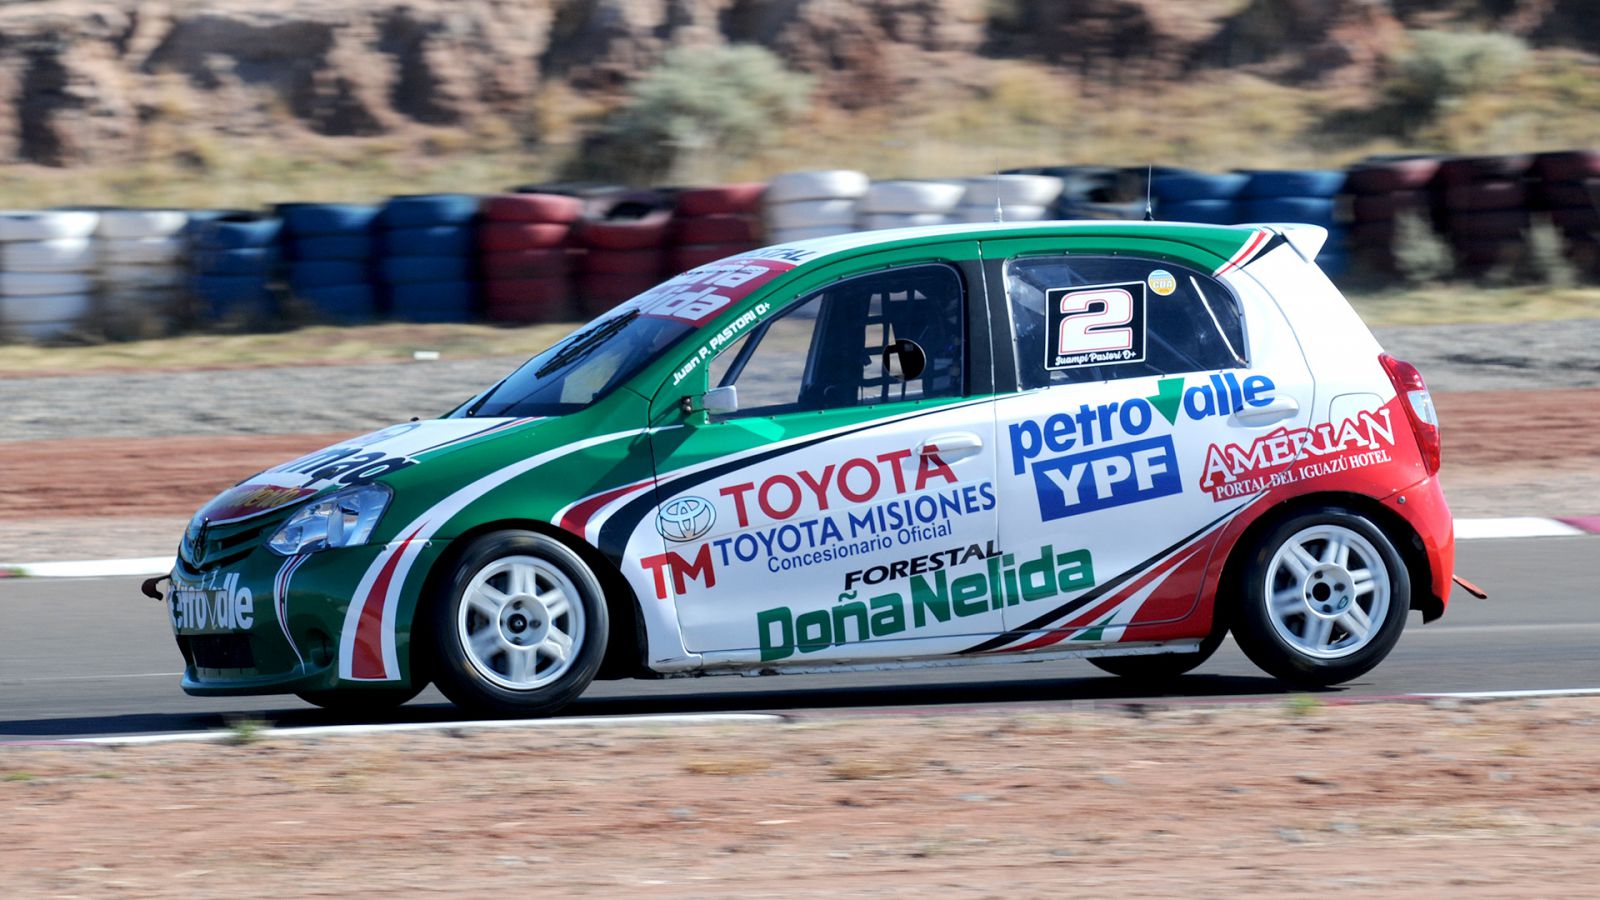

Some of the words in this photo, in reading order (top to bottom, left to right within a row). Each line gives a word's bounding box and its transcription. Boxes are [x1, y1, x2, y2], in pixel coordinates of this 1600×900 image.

[673, 356, 700, 386] Juan
[698, 346, 711, 359] P.
[709, 310, 757, 350] PASTORI
[1058, 288, 1134, 356] 2
[1055, 353, 1088, 366] Juampi
[1089, 351, 1122, 362] Pastori
[1041, 447, 1173, 507] YPF
[1203, 408, 1395, 488] AMÉRIAN
[1216, 476, 1271, 499] PORTAL
[1271, 470, 1299, 487] DEL
[1300, 455, 1348, 481] IGUAZÚ
[1349, 450, 1391, 468] HOTEL
[719, 444, 959, 528] TOYOTA
[713, 515, 845, 566] TOYOTA
[848, 482, 996, 539] MISIONES
[767, 535, 893, 573] Concesionario
[897, 520, 952, 545] Oficial
[640, 542, 716, 600] TM
[845, 540, 1003, 590] FORESTAL
[757, 590, 906, 662] Doña
[909, 544, 1096, 629] Nelida
